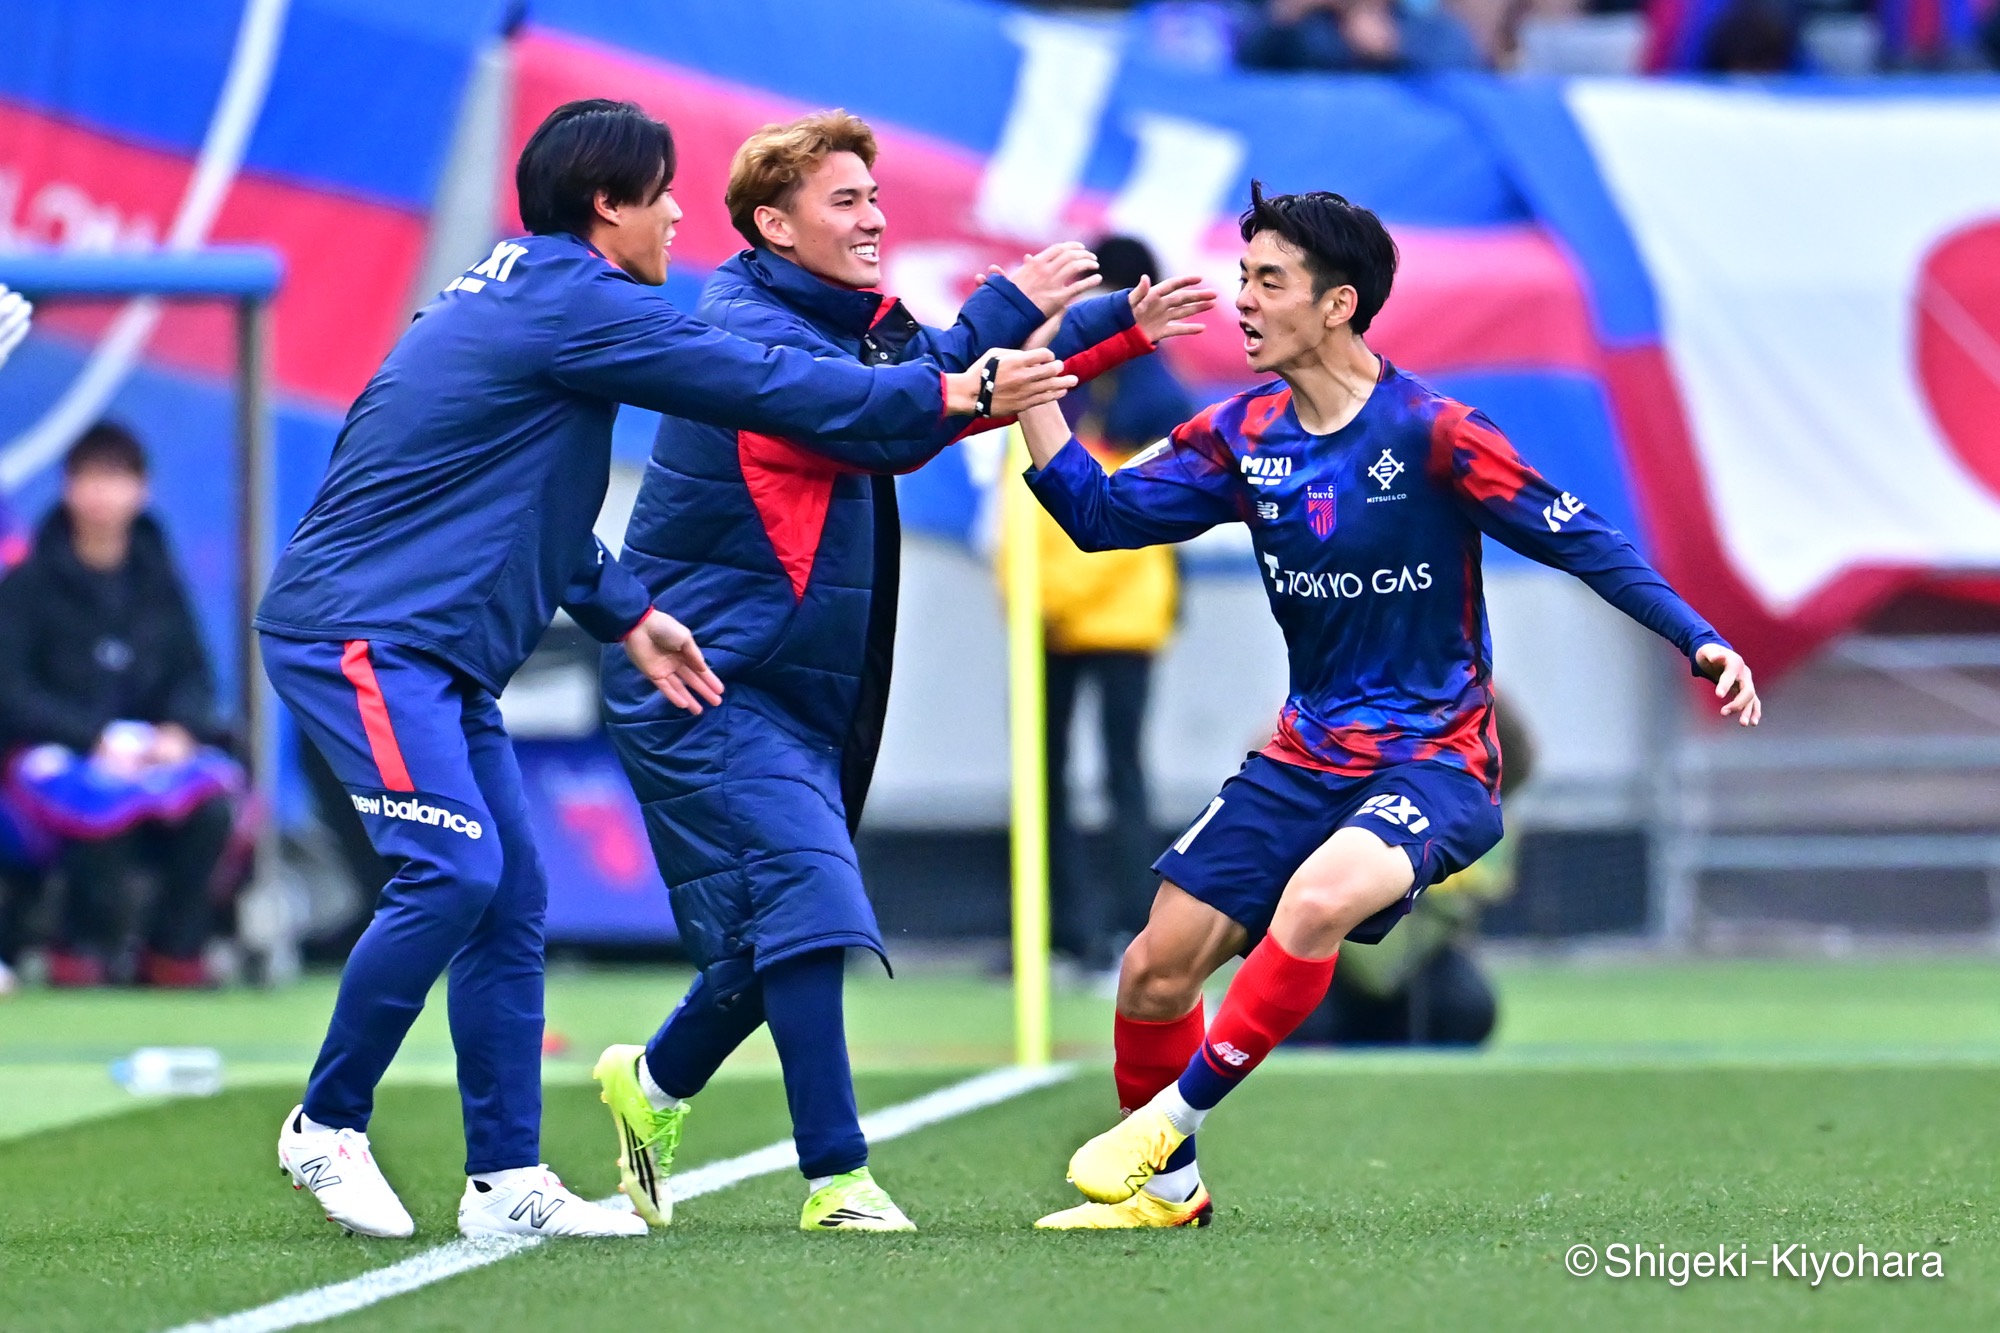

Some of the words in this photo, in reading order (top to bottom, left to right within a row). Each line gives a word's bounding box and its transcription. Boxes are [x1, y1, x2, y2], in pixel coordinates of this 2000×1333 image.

[466, 241, 529, 283] XI
[1240, 455, 1293, 477] MIXI
[1366, 495, 1391, 504] MITSUI
[1284, 570, 1363, 598] TOKYO
[1372, 562, 1433, 594] GAS
[351, 794, 380, 815] new
[382, 795, 483, 839] balance
